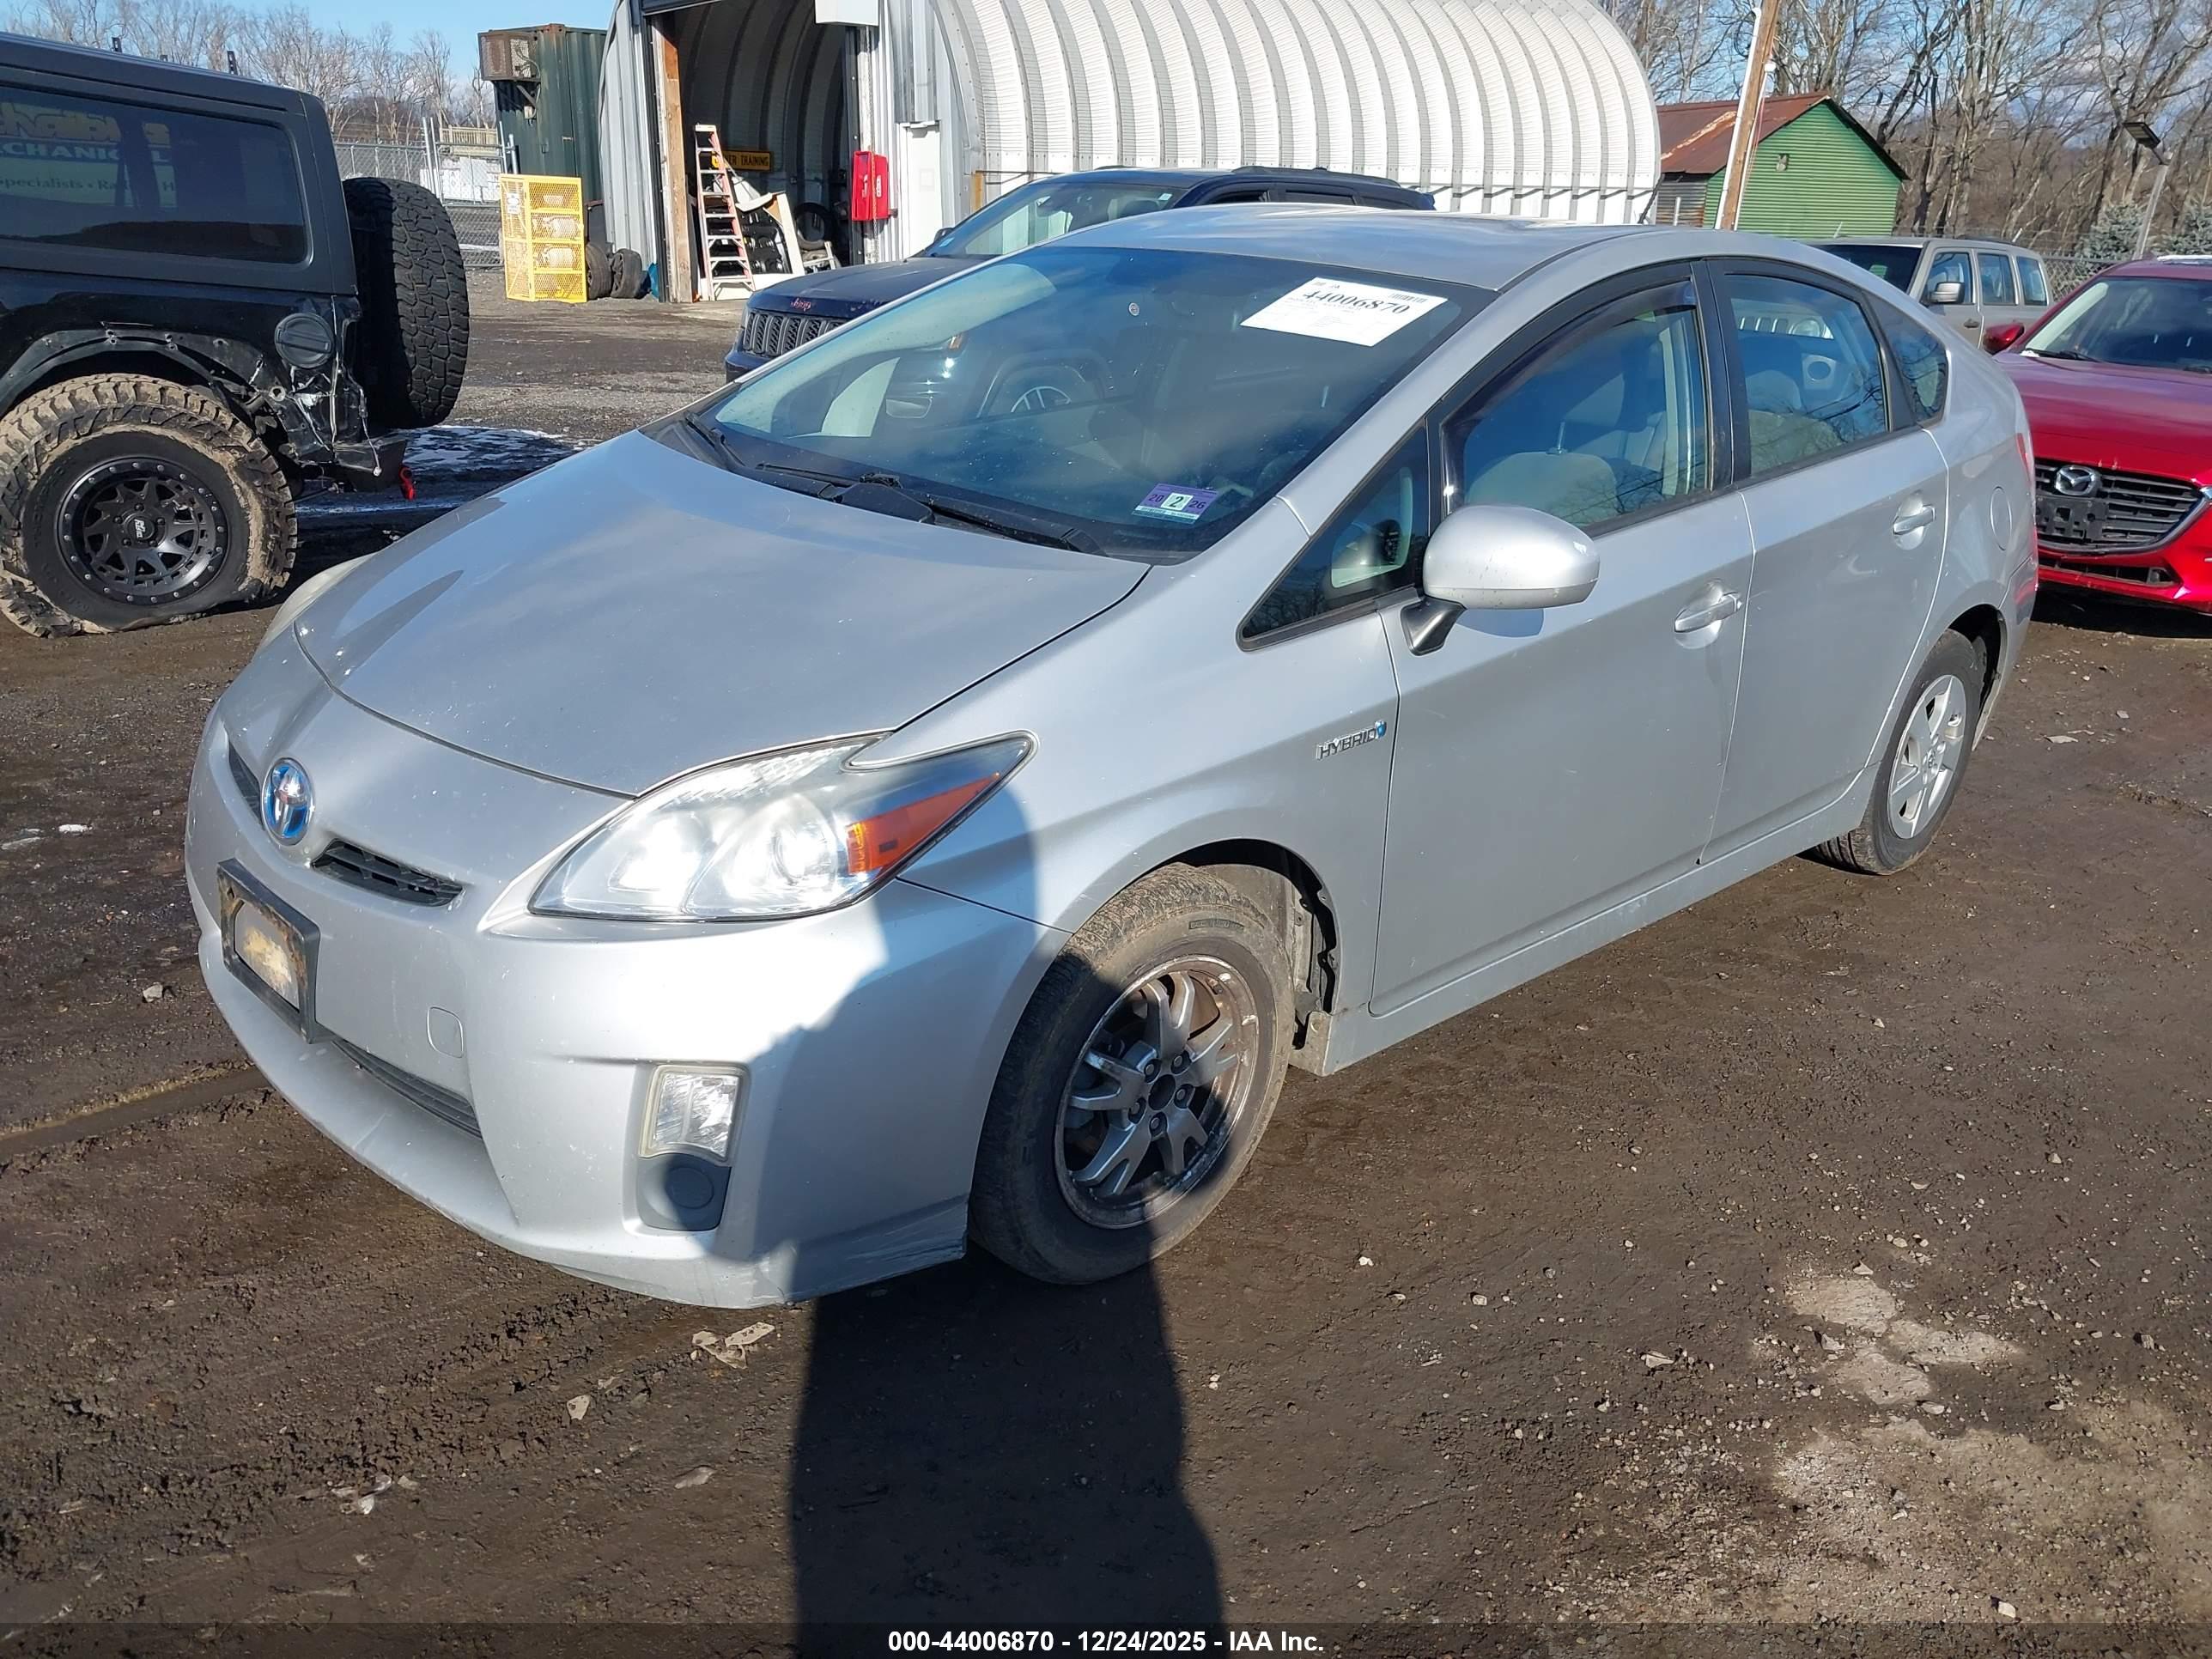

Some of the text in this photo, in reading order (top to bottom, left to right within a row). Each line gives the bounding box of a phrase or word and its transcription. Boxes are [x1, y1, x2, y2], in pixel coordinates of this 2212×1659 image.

[1302, 289, 1411, 314] 44006870
[1148, 494, 1206, 509] 20 2 26
[1316, 727, 1377, 761] HYBRID
